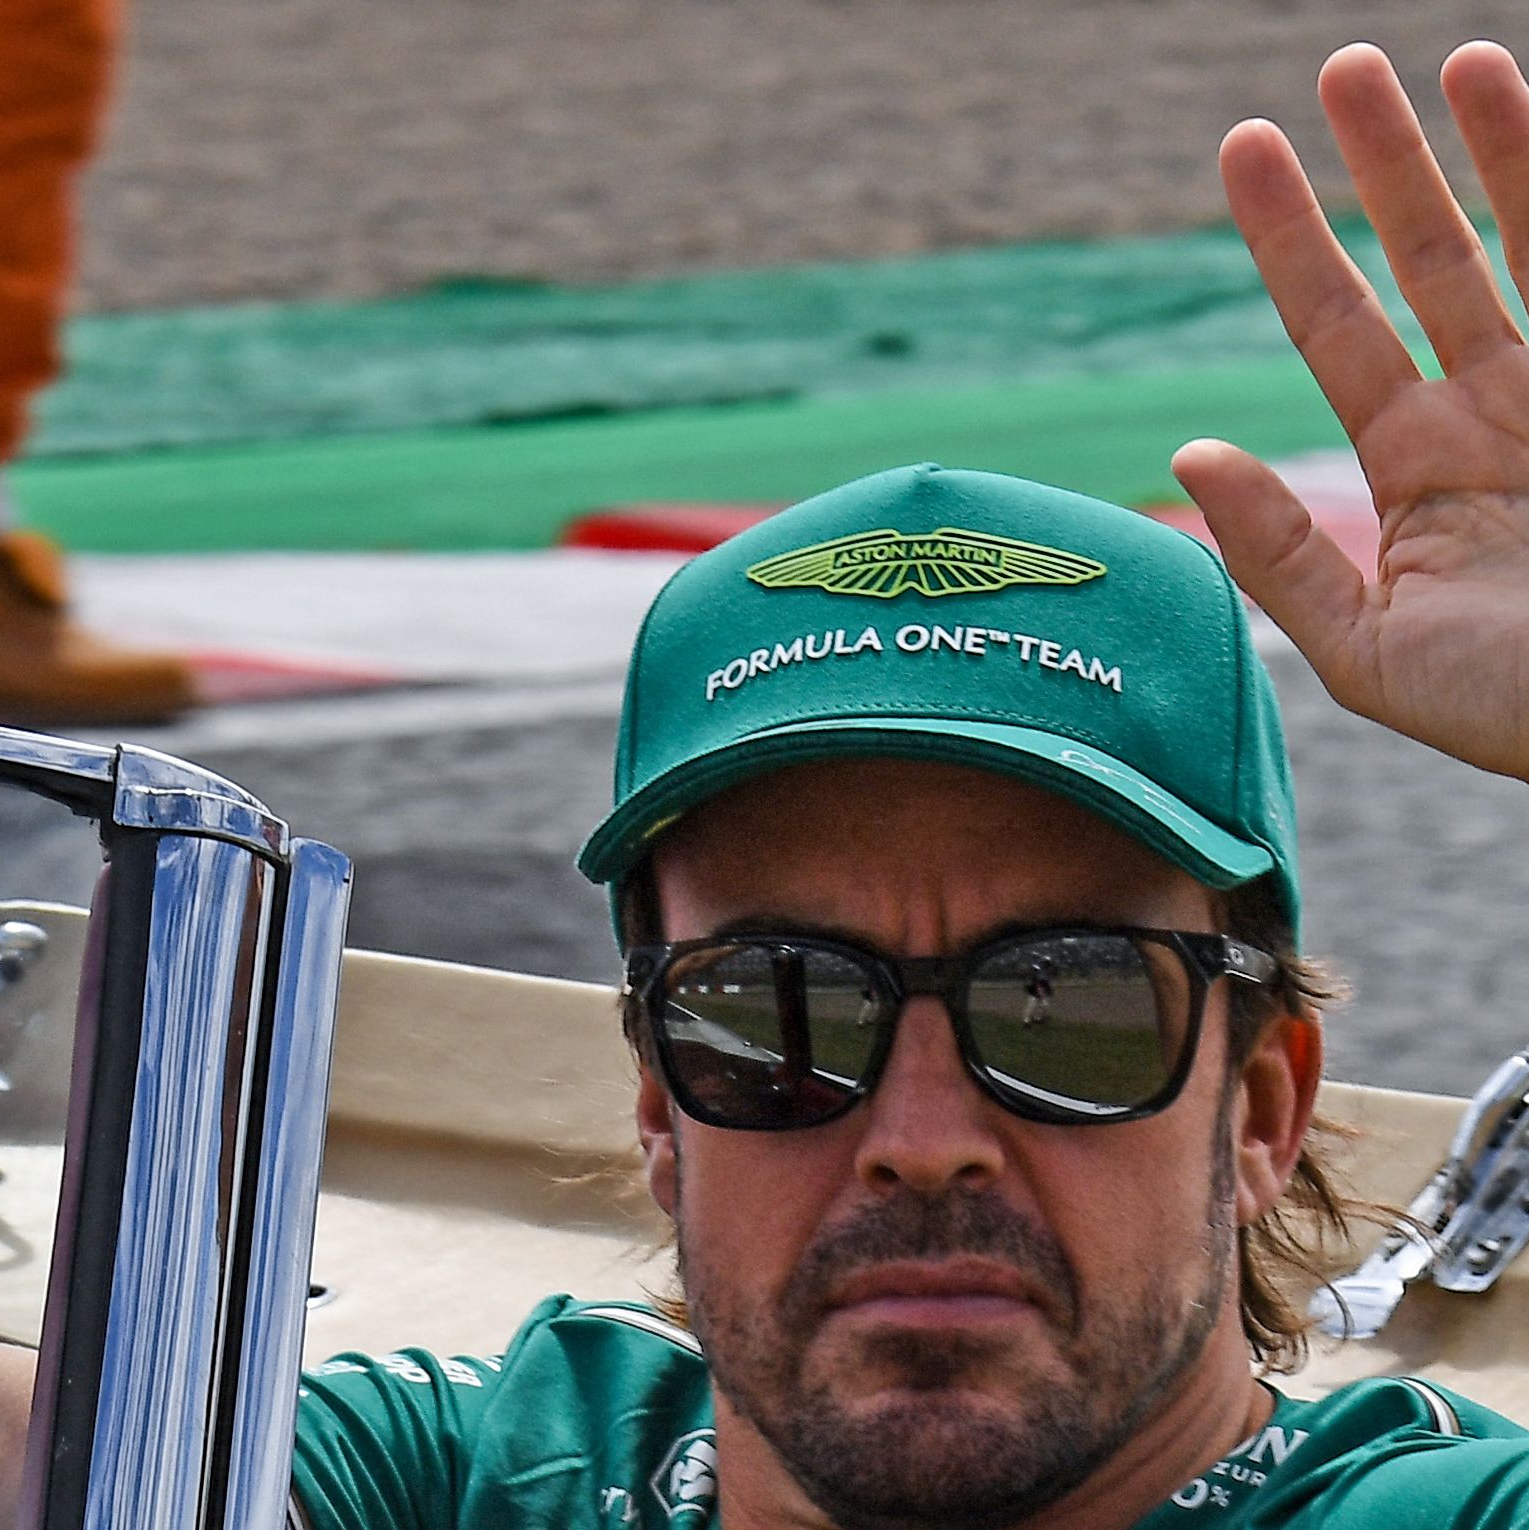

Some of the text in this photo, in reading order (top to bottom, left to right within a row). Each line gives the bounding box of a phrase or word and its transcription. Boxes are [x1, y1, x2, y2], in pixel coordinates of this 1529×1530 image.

[835, 541, 999, 568] ASTON MARTIN
[705, 626, 883, 701] FORMULA
[1012, 633, 1123, 693] TEAM
